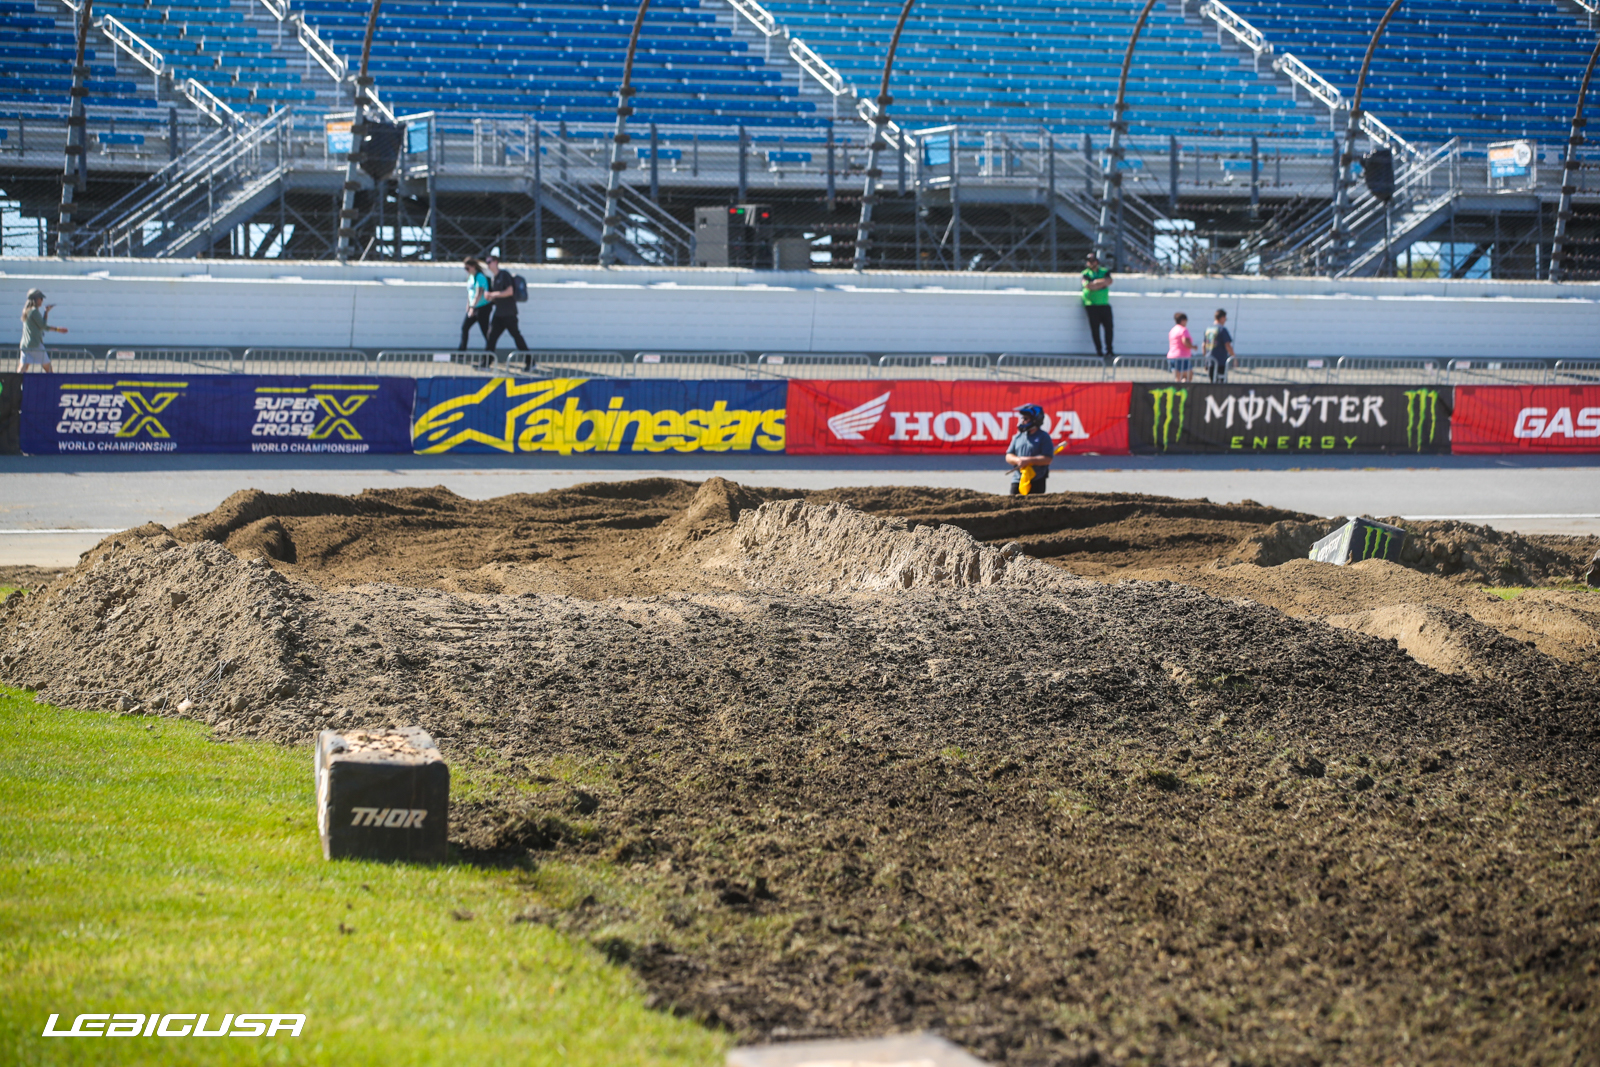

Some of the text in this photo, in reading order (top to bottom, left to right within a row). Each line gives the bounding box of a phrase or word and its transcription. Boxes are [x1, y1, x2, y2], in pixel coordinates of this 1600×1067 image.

[59, 393, 127, 408] SUPER
[253, 397, 320, 411] SUPER
[62, 407, 122, 421] MOTO
[256, 410, 315, 423] MOTO
[56, 421, 122, 434] CROSS
[251, 423, 315, 437] CROSS
[517, 397, 786, 456] alpinestars
[58, 441, 178, 452] WORLD CHAMPIONSHIP
[251, 442, 370, 453] WORLD CHAMPIONSHIP
[1230, 435, 1358, 449] ENERGY
[351, 807, 428, 829] THOR
